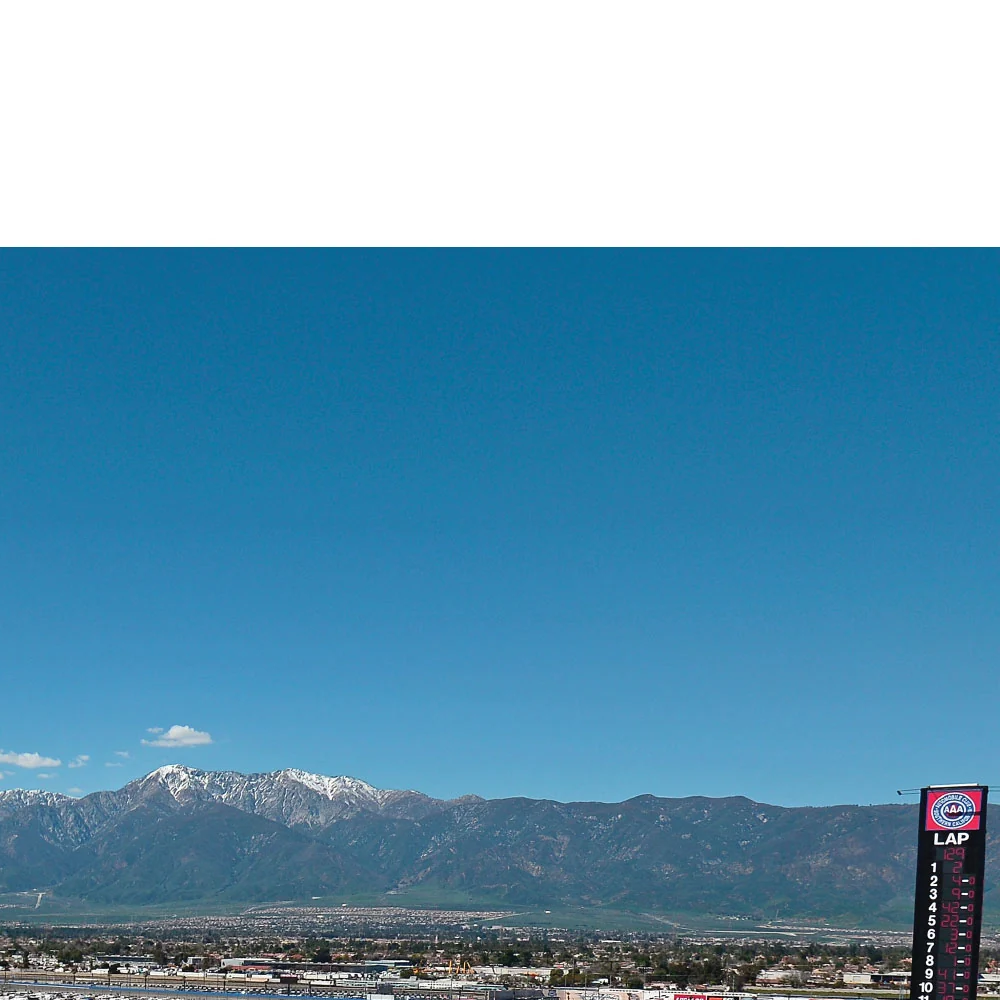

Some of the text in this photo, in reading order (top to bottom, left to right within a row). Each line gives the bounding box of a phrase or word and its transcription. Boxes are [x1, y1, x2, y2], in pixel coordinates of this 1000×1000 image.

[944, 804, 964, 814] AAA
[934, 832, 970, 846] LAP
[943, 848, 965, 860] 129
[931, 862, 962, 873] 1 2
[930, 876, 938, 886] 2
[929, 889, 938, 899] 3
[928, 902, 937, 912] 4
[928, 915, 936, 926] 5
[927, 929, 936, 940] 6
[926, 943, 935, 952] 7
[926, 955, 934, 966] 8
[925, 968, 934, 979] 9
[919, 982, 933, 993] 10
